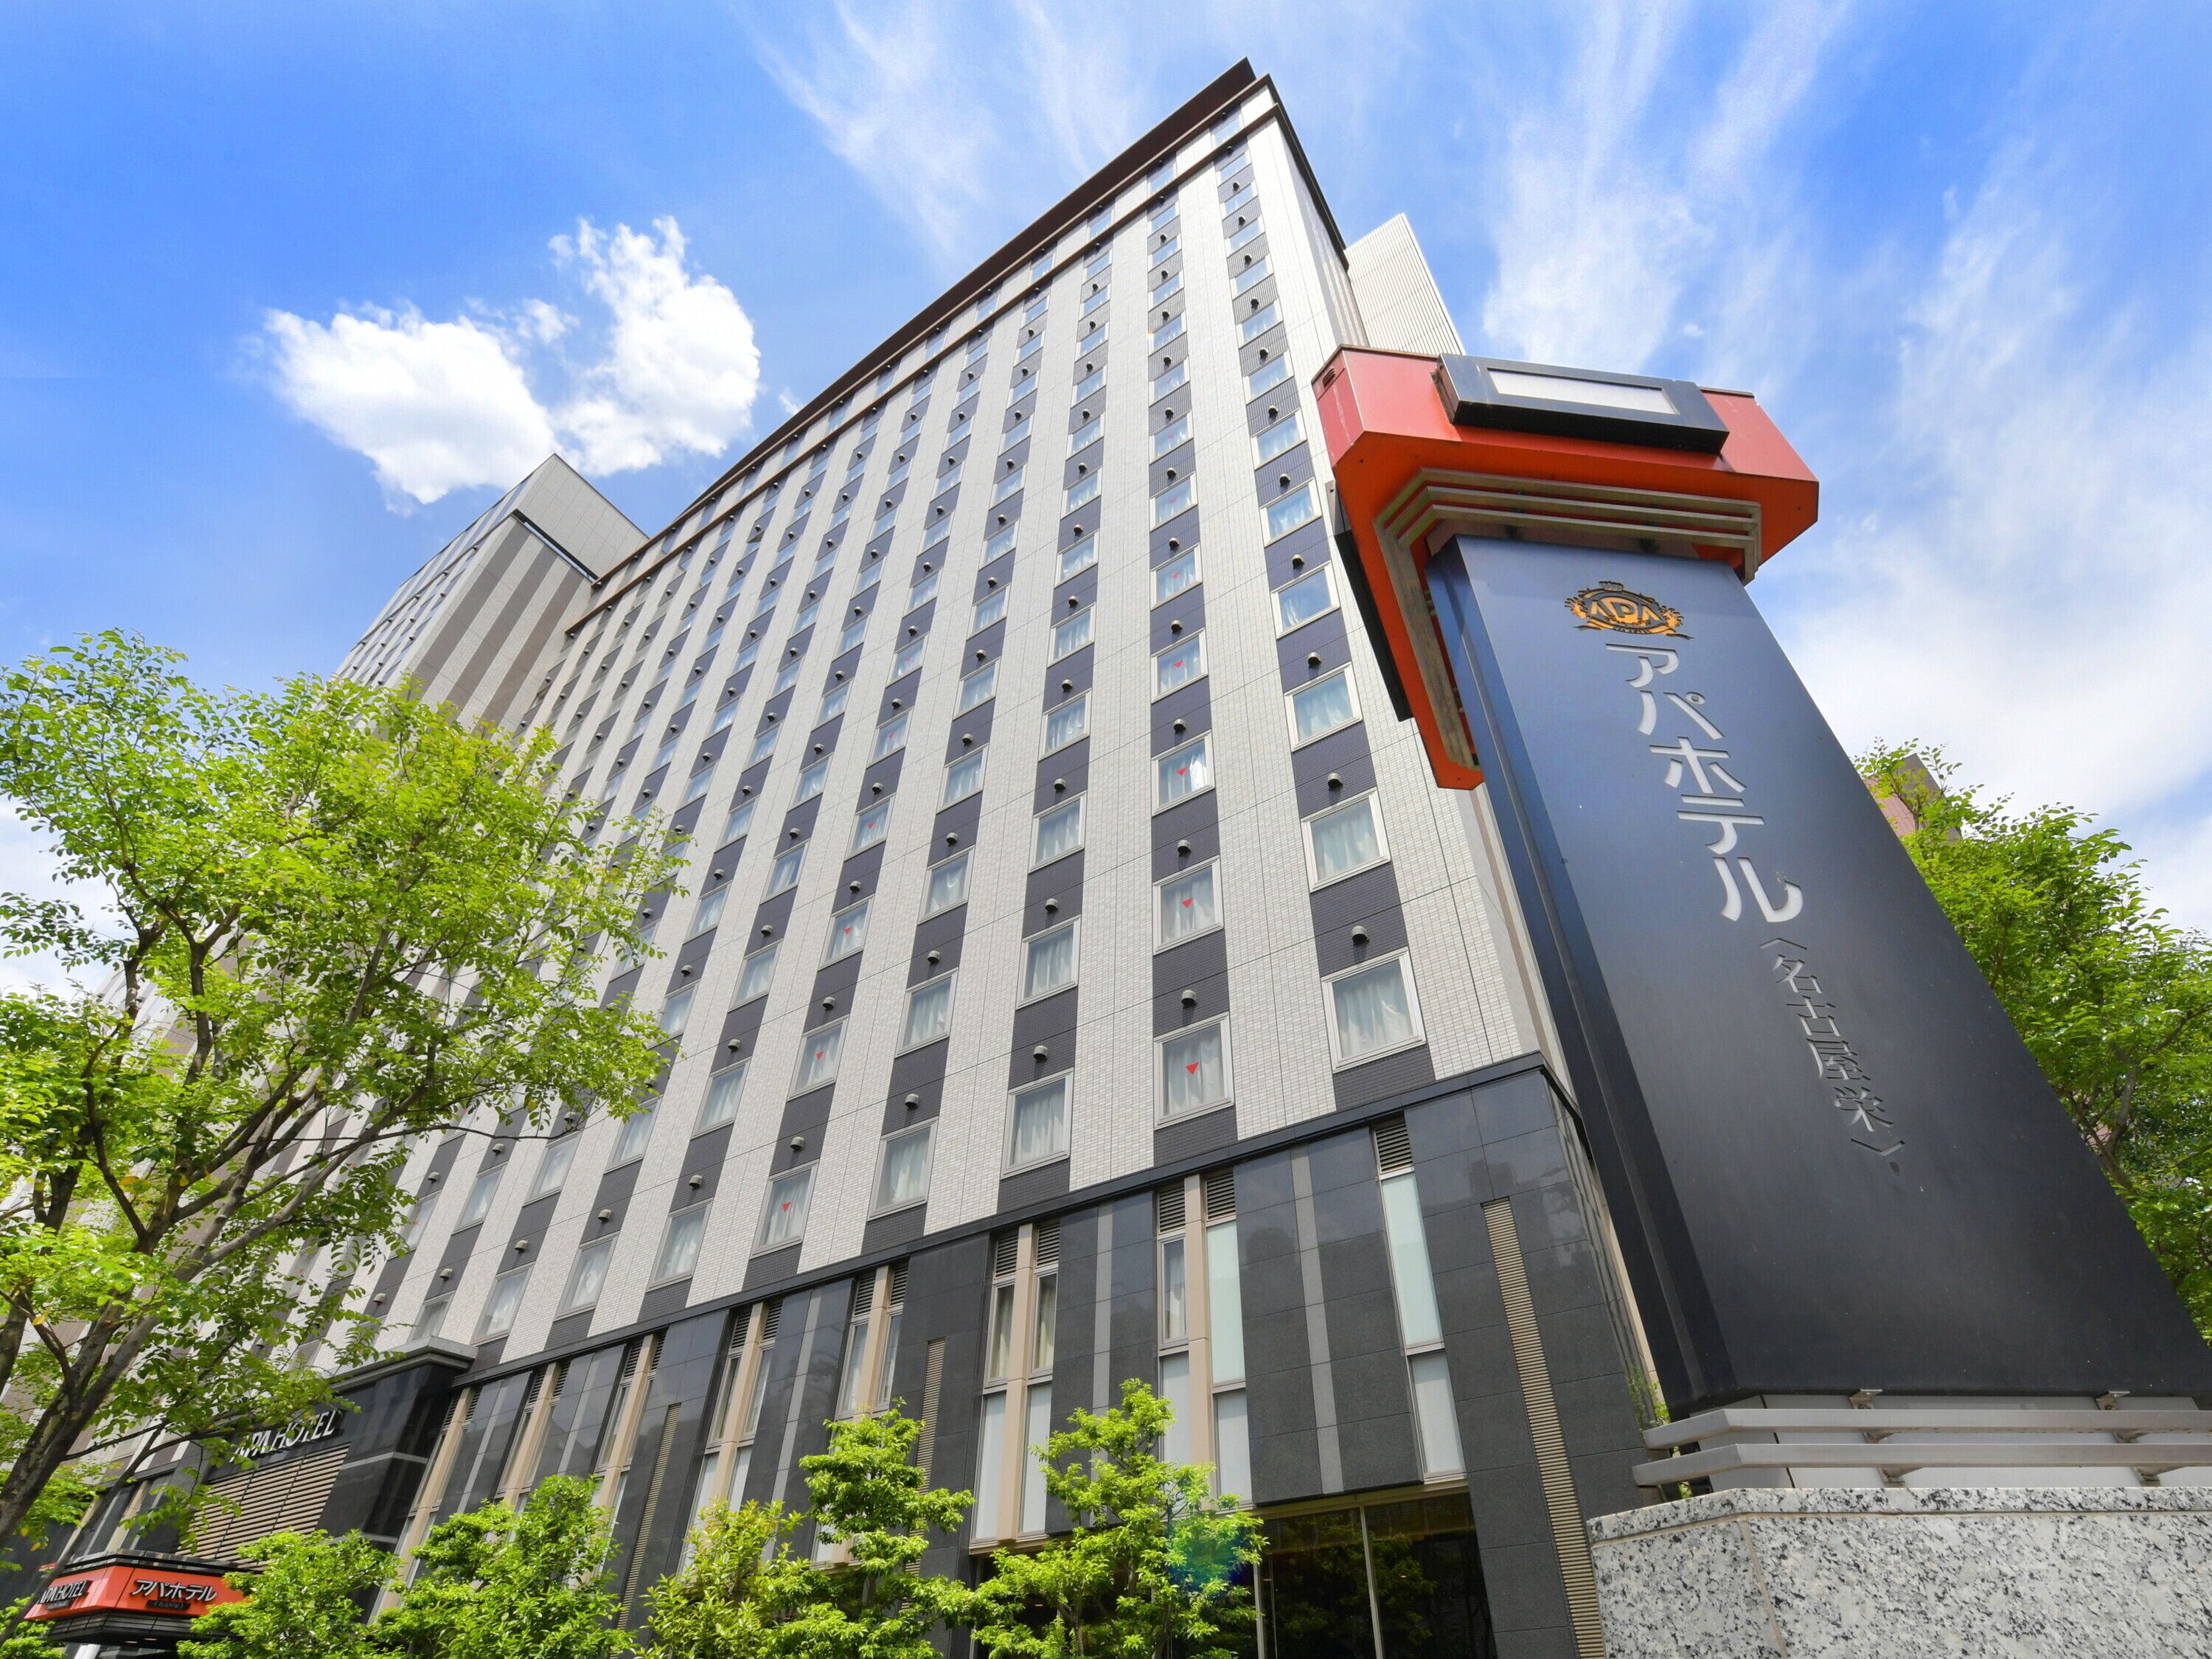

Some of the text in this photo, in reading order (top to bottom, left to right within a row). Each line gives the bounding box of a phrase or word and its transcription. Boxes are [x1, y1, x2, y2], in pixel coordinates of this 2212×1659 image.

[1605, 643, 1804, 923] アパホテル
[55, 1580, 88, 1601] HOTEL
[132, 1579, 218, 1601] アパホテル
